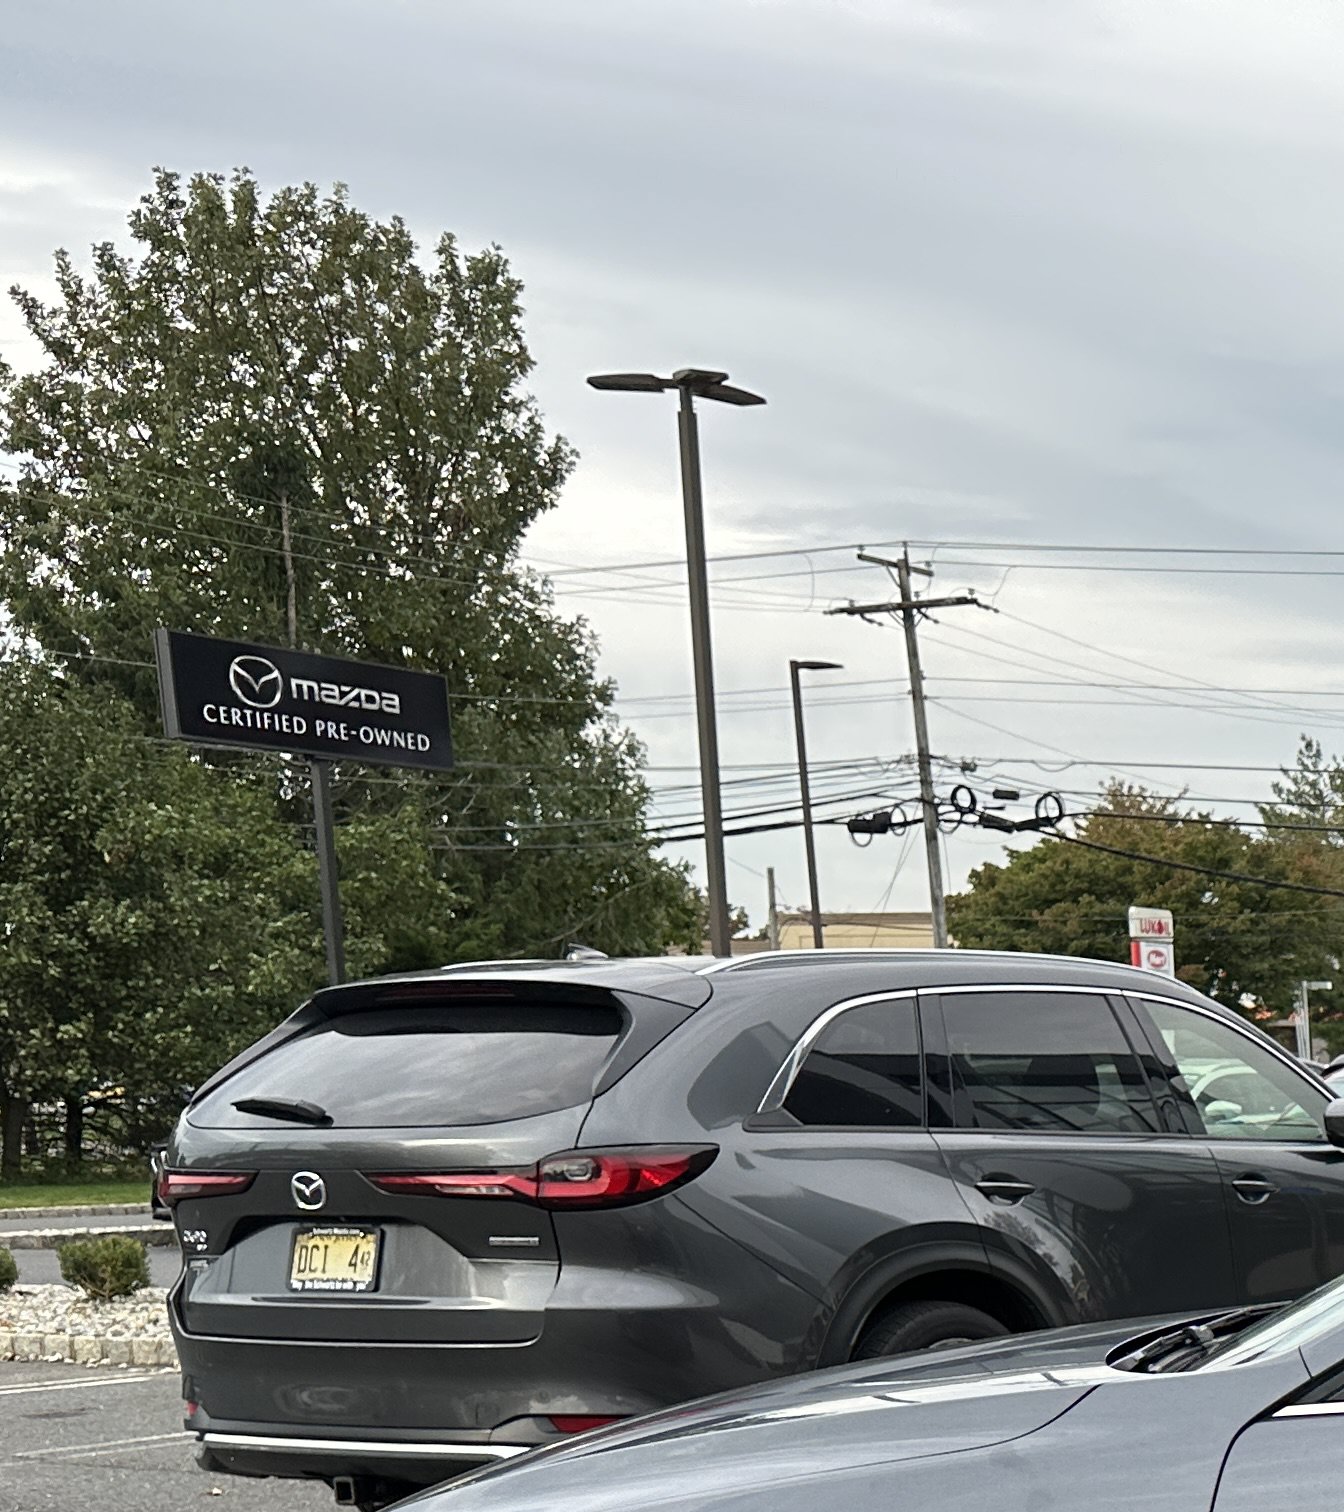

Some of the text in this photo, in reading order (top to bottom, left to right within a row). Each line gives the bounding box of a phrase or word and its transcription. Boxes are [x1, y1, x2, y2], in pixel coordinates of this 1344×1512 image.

[290, 677, 400, 714] mazda
[203, 703, 430, 752] CERTIFIED PRE-OWNED
